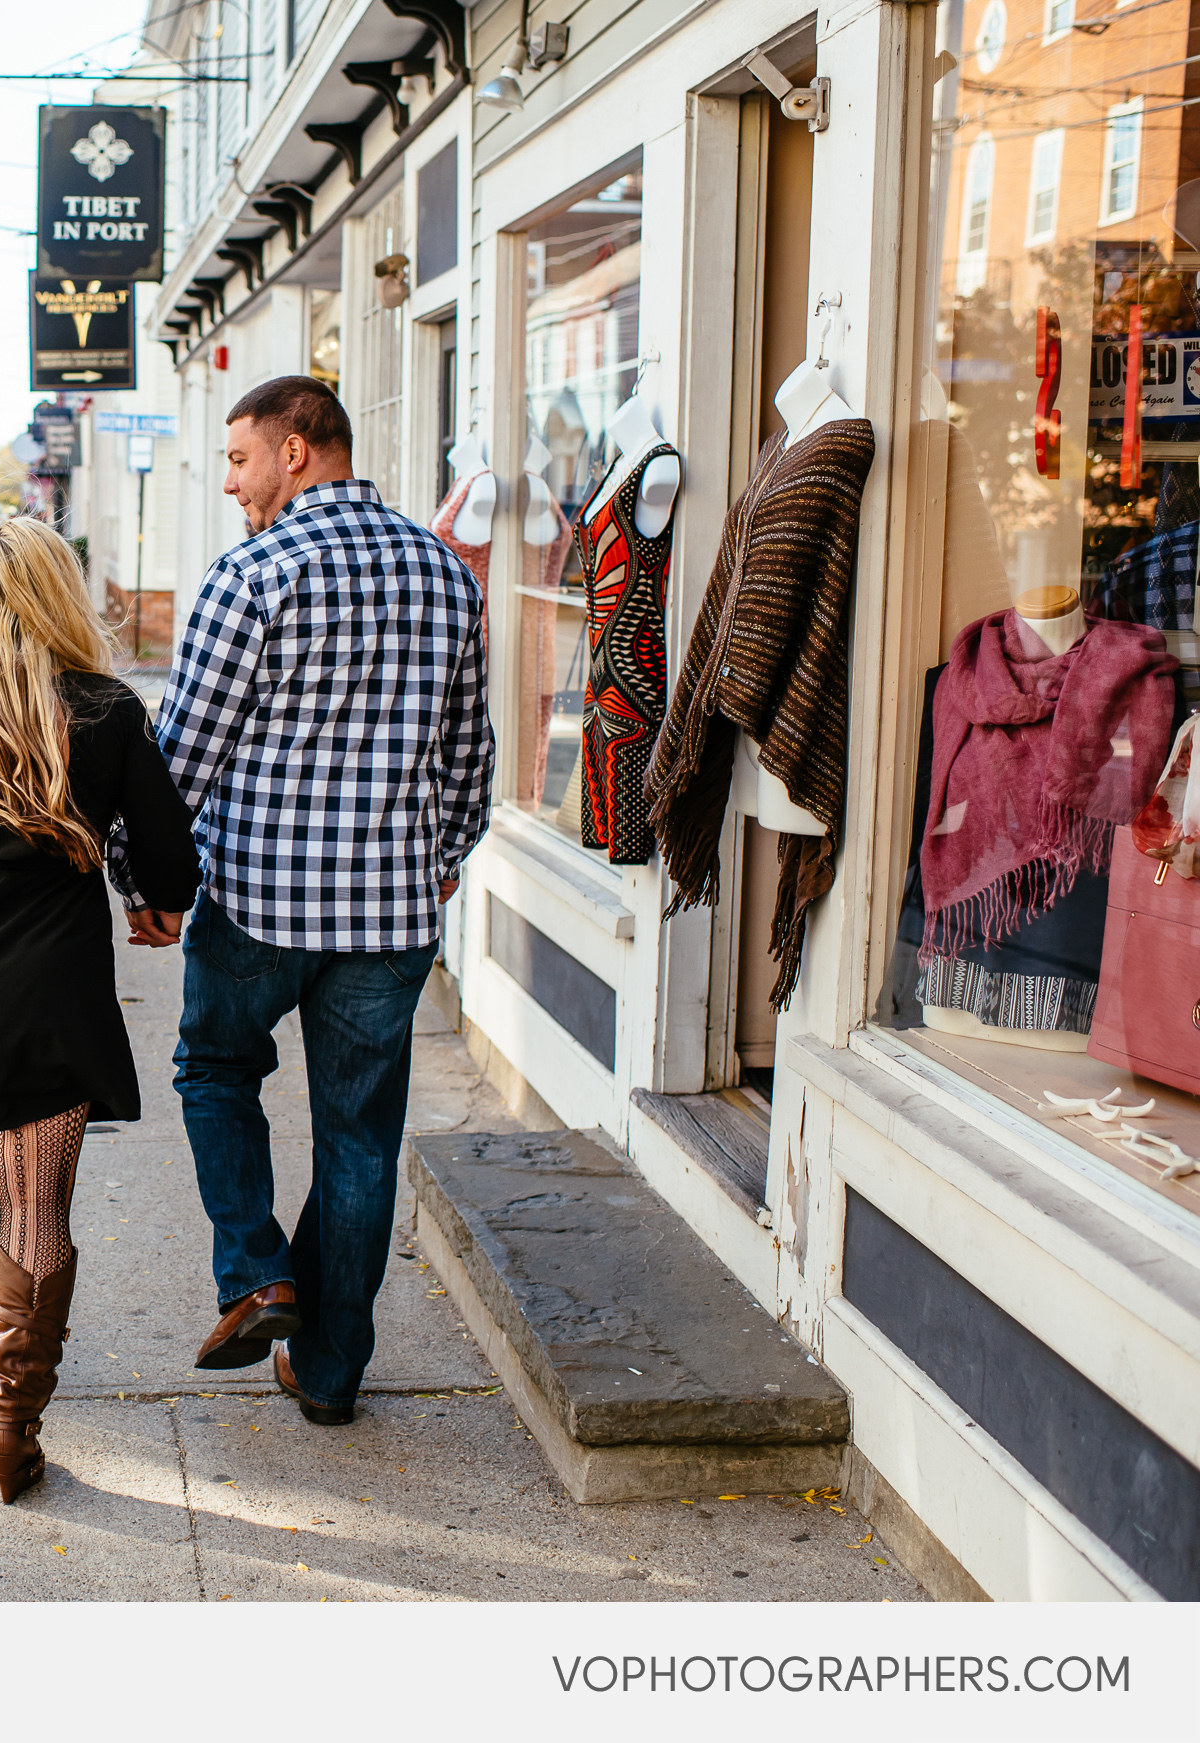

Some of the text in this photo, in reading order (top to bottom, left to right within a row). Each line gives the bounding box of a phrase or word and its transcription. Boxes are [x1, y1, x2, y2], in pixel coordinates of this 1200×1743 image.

[62, 196, 141, 217] TIBET
[53, 221, 149, 241] IN PORT
[1090, 343, 1177, 388] LOED
[1141, 394, 1175, 408] Again
